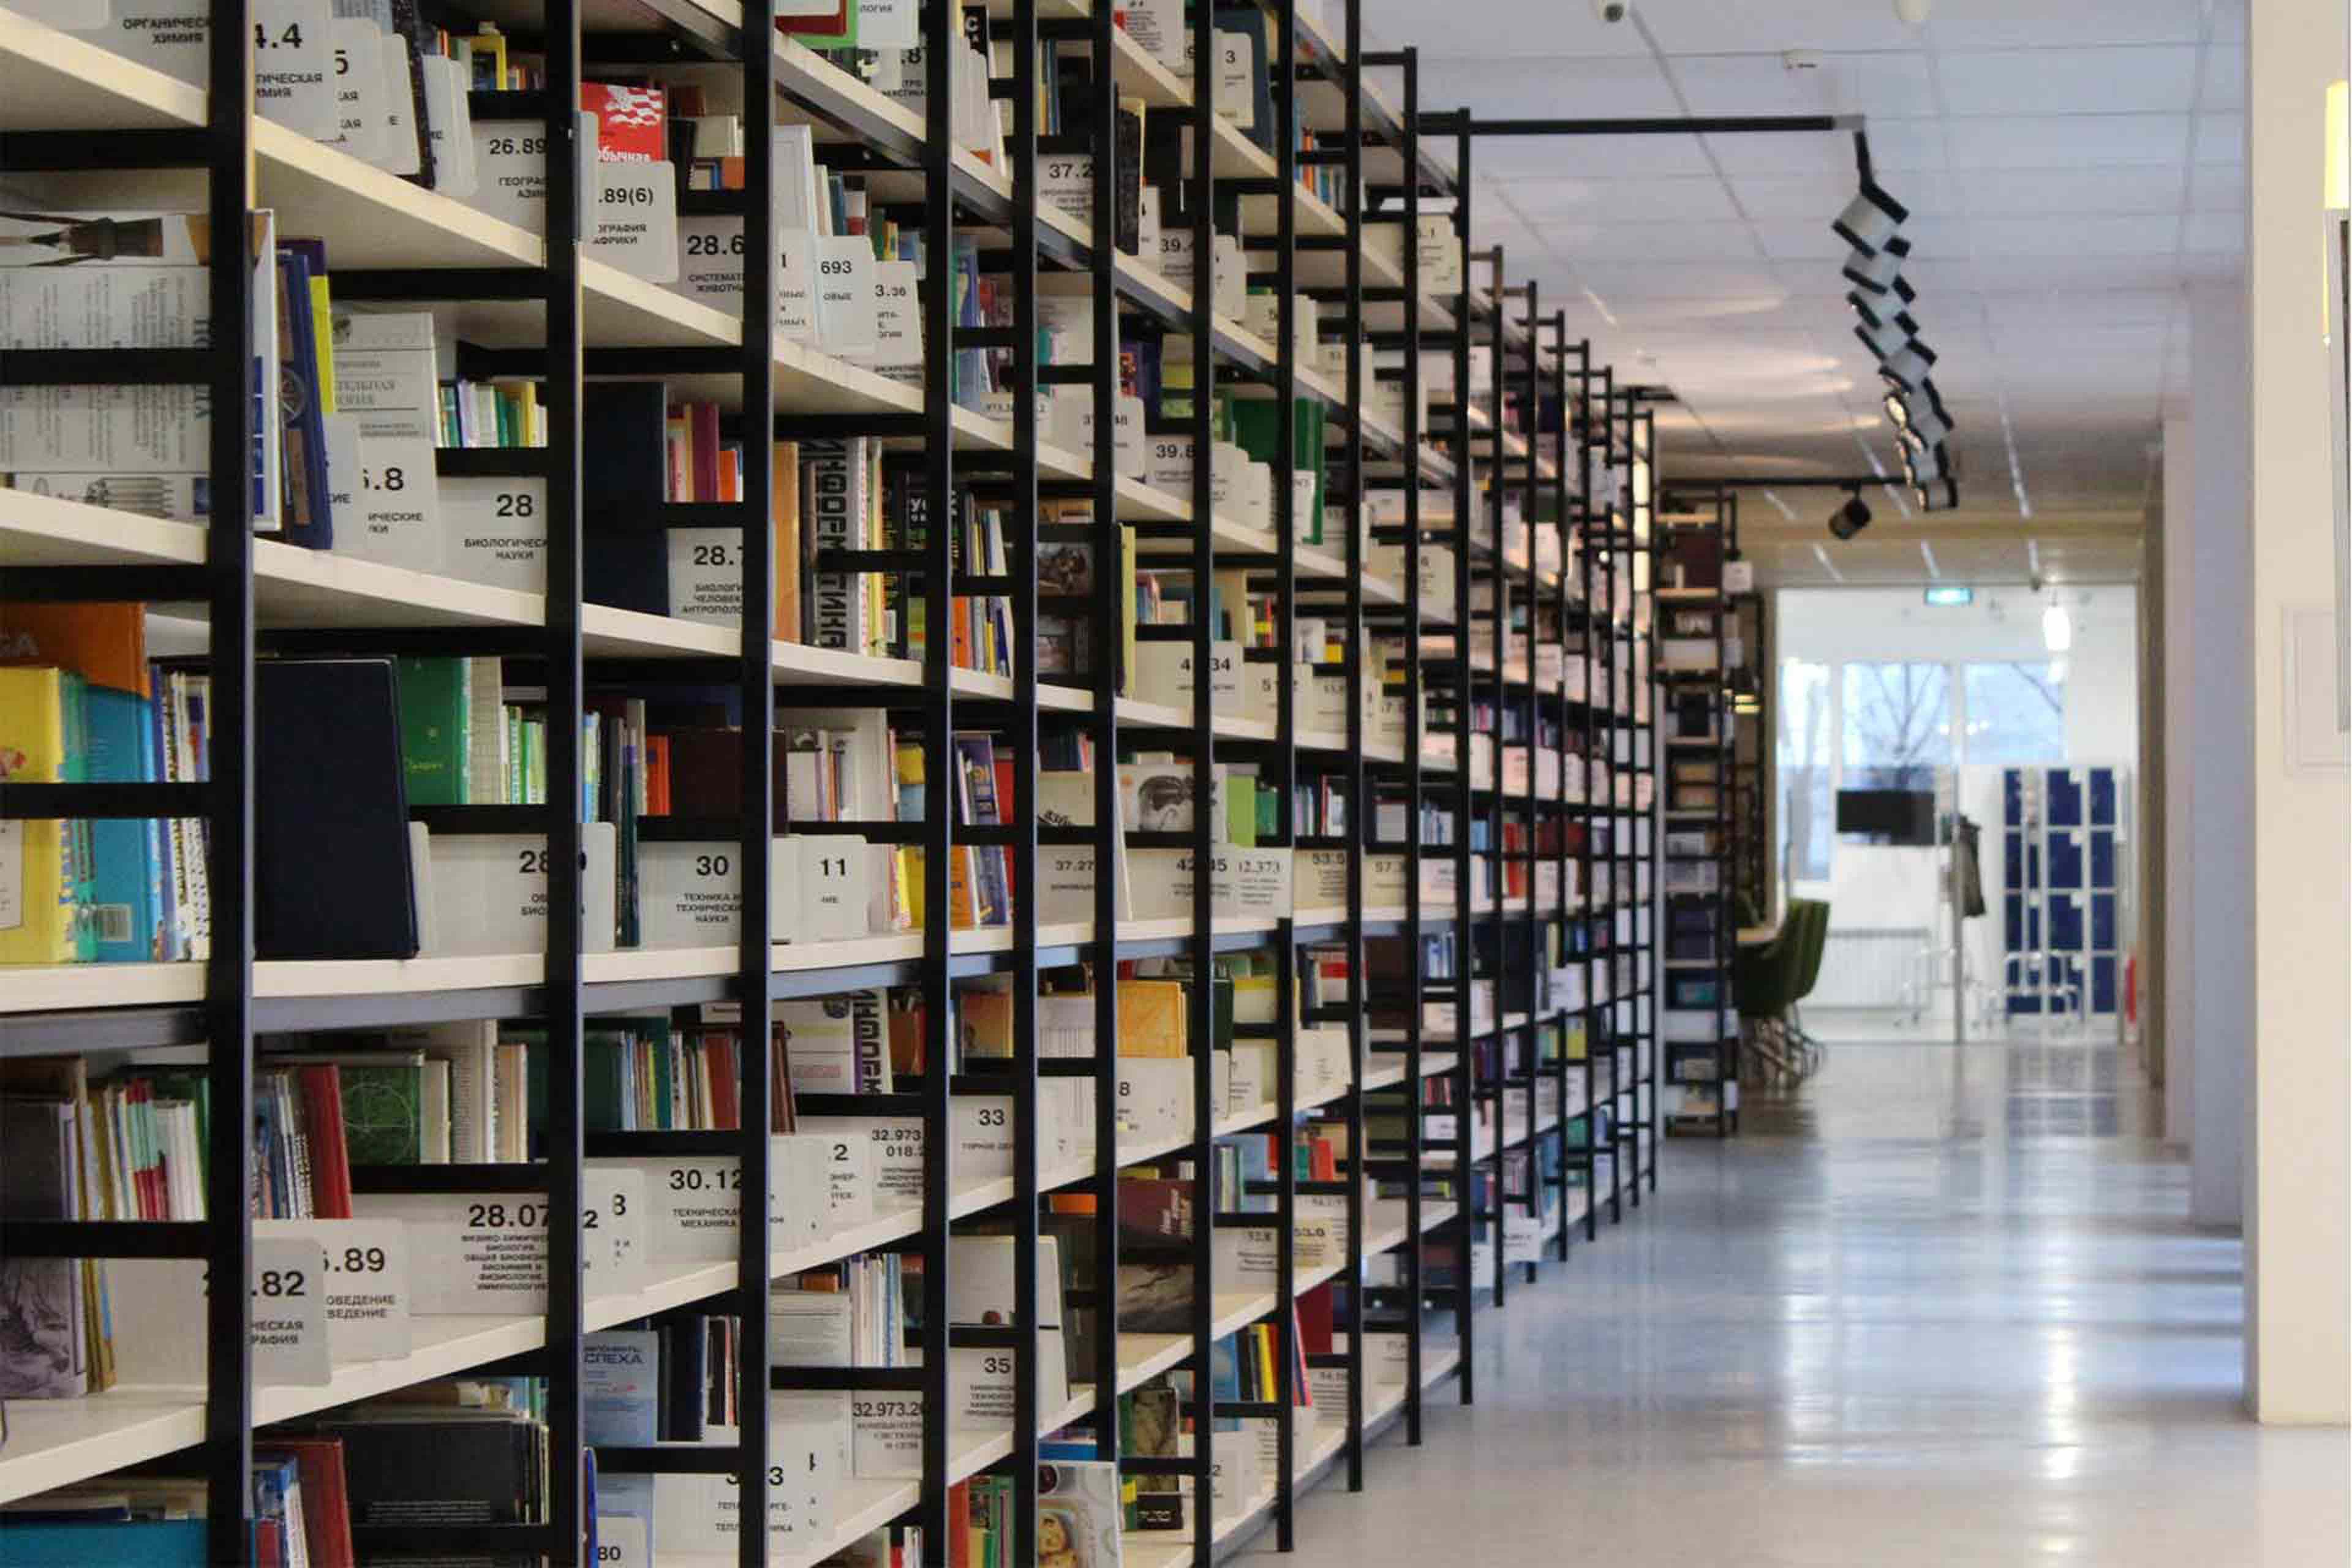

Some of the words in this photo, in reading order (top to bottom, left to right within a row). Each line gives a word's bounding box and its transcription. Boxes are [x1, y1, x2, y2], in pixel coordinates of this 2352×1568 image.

[152, 32, 203, 43] ХИМИЯ
[490, 138, 546, 155] 26.89
[821, 260, 853, 275] 693
[496, 494, 533, 518] 28
[817, 437, 847, 649] ИНФОРМТИКА
[496, 551, 534, 560] НАУКИ
[695, 856, 729, 877] 30
[821, 858, 846, 876] 11
[979, 1109, 1005, 1126] 33
[834, 1144, 849, 1161] 2
[469, 1204, 549, 1227] 28.07
[582, 1210, 598, 1229] 2
[984, 1357, 1011, 1373] 35
[852, 1401, 922, 1417] 32.973.2
